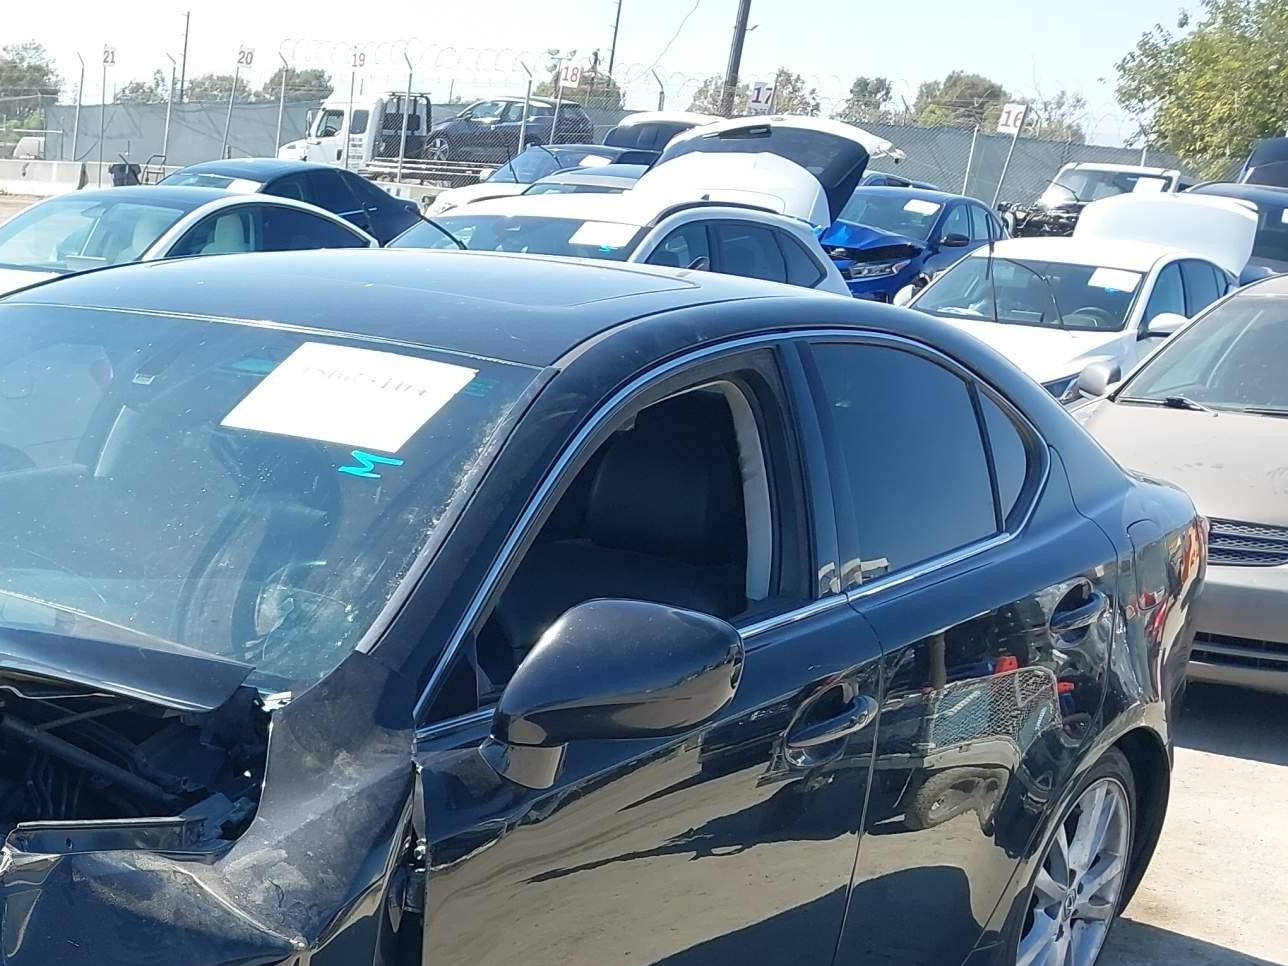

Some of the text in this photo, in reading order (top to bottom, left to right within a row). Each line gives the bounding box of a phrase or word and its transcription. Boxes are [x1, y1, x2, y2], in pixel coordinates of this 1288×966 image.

[103, 50, 115, 64] 21
[236, 50, 253, 65] 20
[351, 52, 366, 67] 19
[561, 65, 579, 82] 18
[751, 86, 773, 105] 17
[1000, 110, 1023, 129] 16
